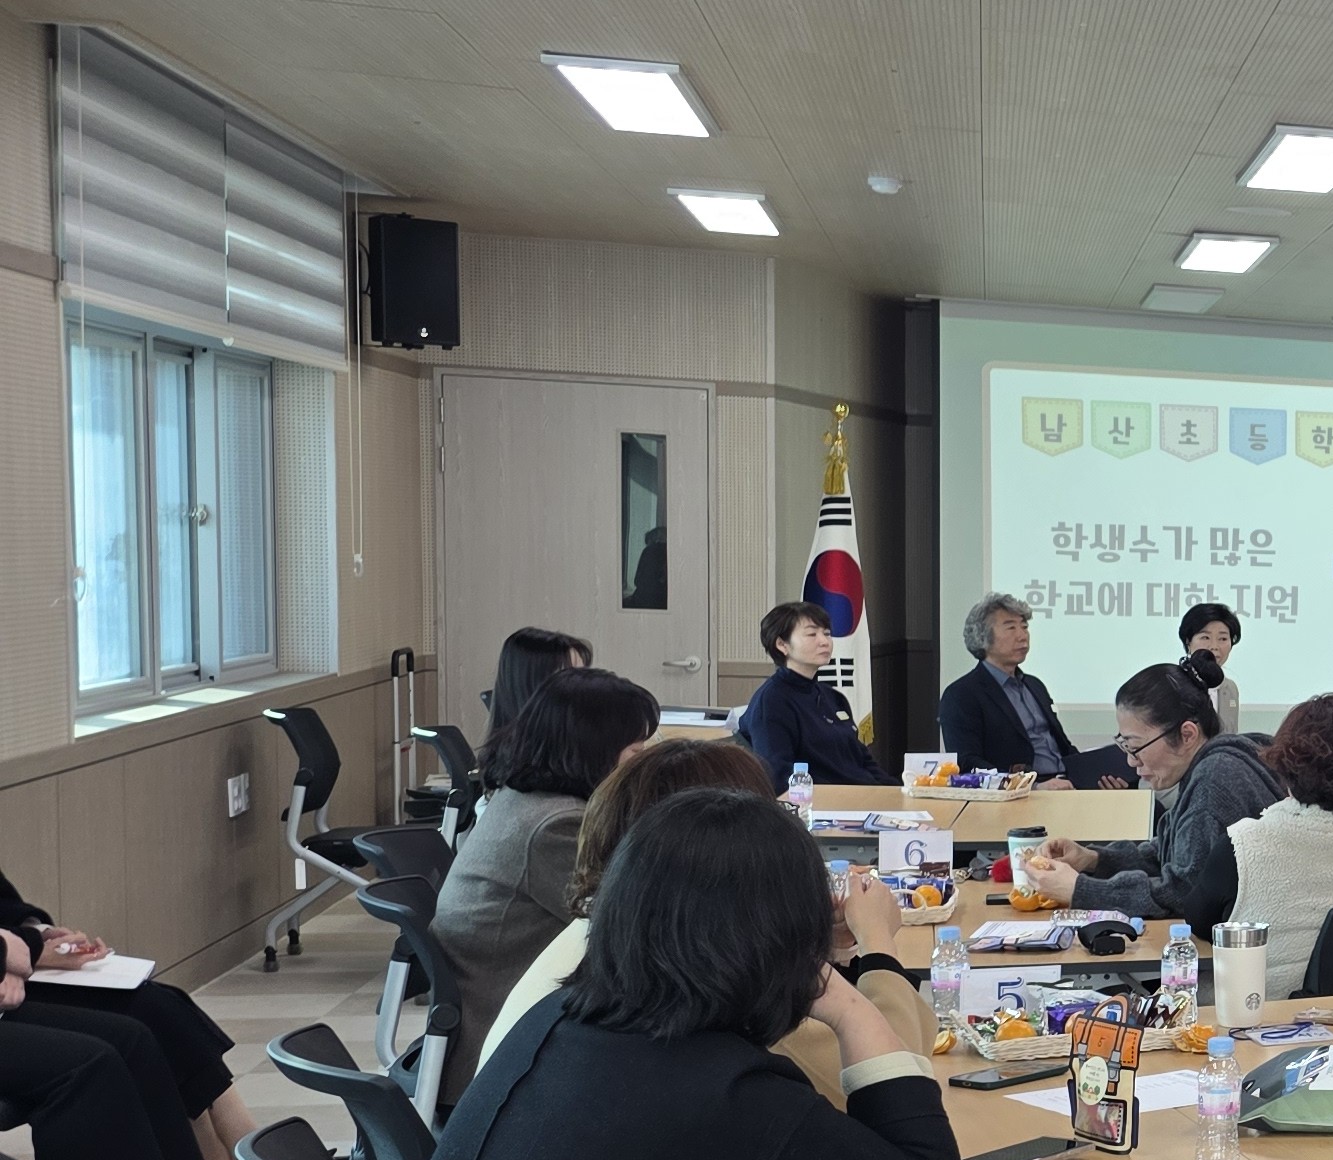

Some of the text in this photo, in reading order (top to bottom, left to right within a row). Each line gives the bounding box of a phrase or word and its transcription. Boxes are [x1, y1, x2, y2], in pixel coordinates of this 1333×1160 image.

[1051, 521, 1277, 568] 학생수가 많은
[1024, 579, 1133, 620] 학교에
[1229, 581, 1299, 624] 지원
[904, 839, 928, 867] 6
[994, 976, 1026, 1014] 5
